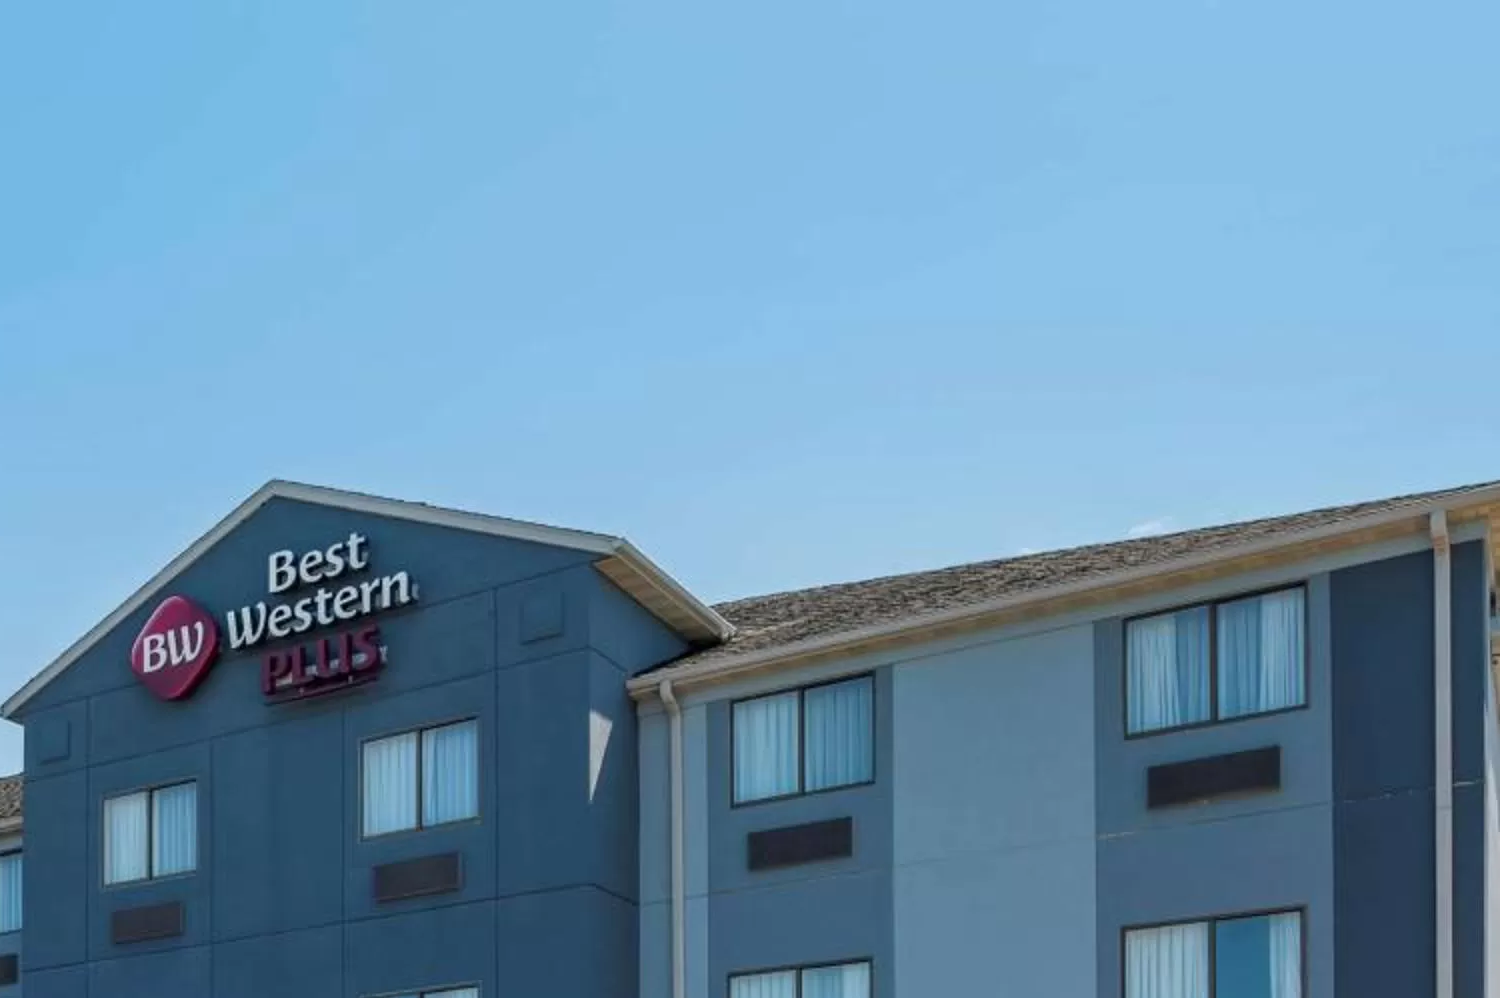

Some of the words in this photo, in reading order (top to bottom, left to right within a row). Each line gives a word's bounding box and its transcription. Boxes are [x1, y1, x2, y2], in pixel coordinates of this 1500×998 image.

[267, 530, 367, 593] Best
[226, 569, 411, 650] Western
[142, 621, 204, 673] BW
[260, 625, 382, 695] PLUS
